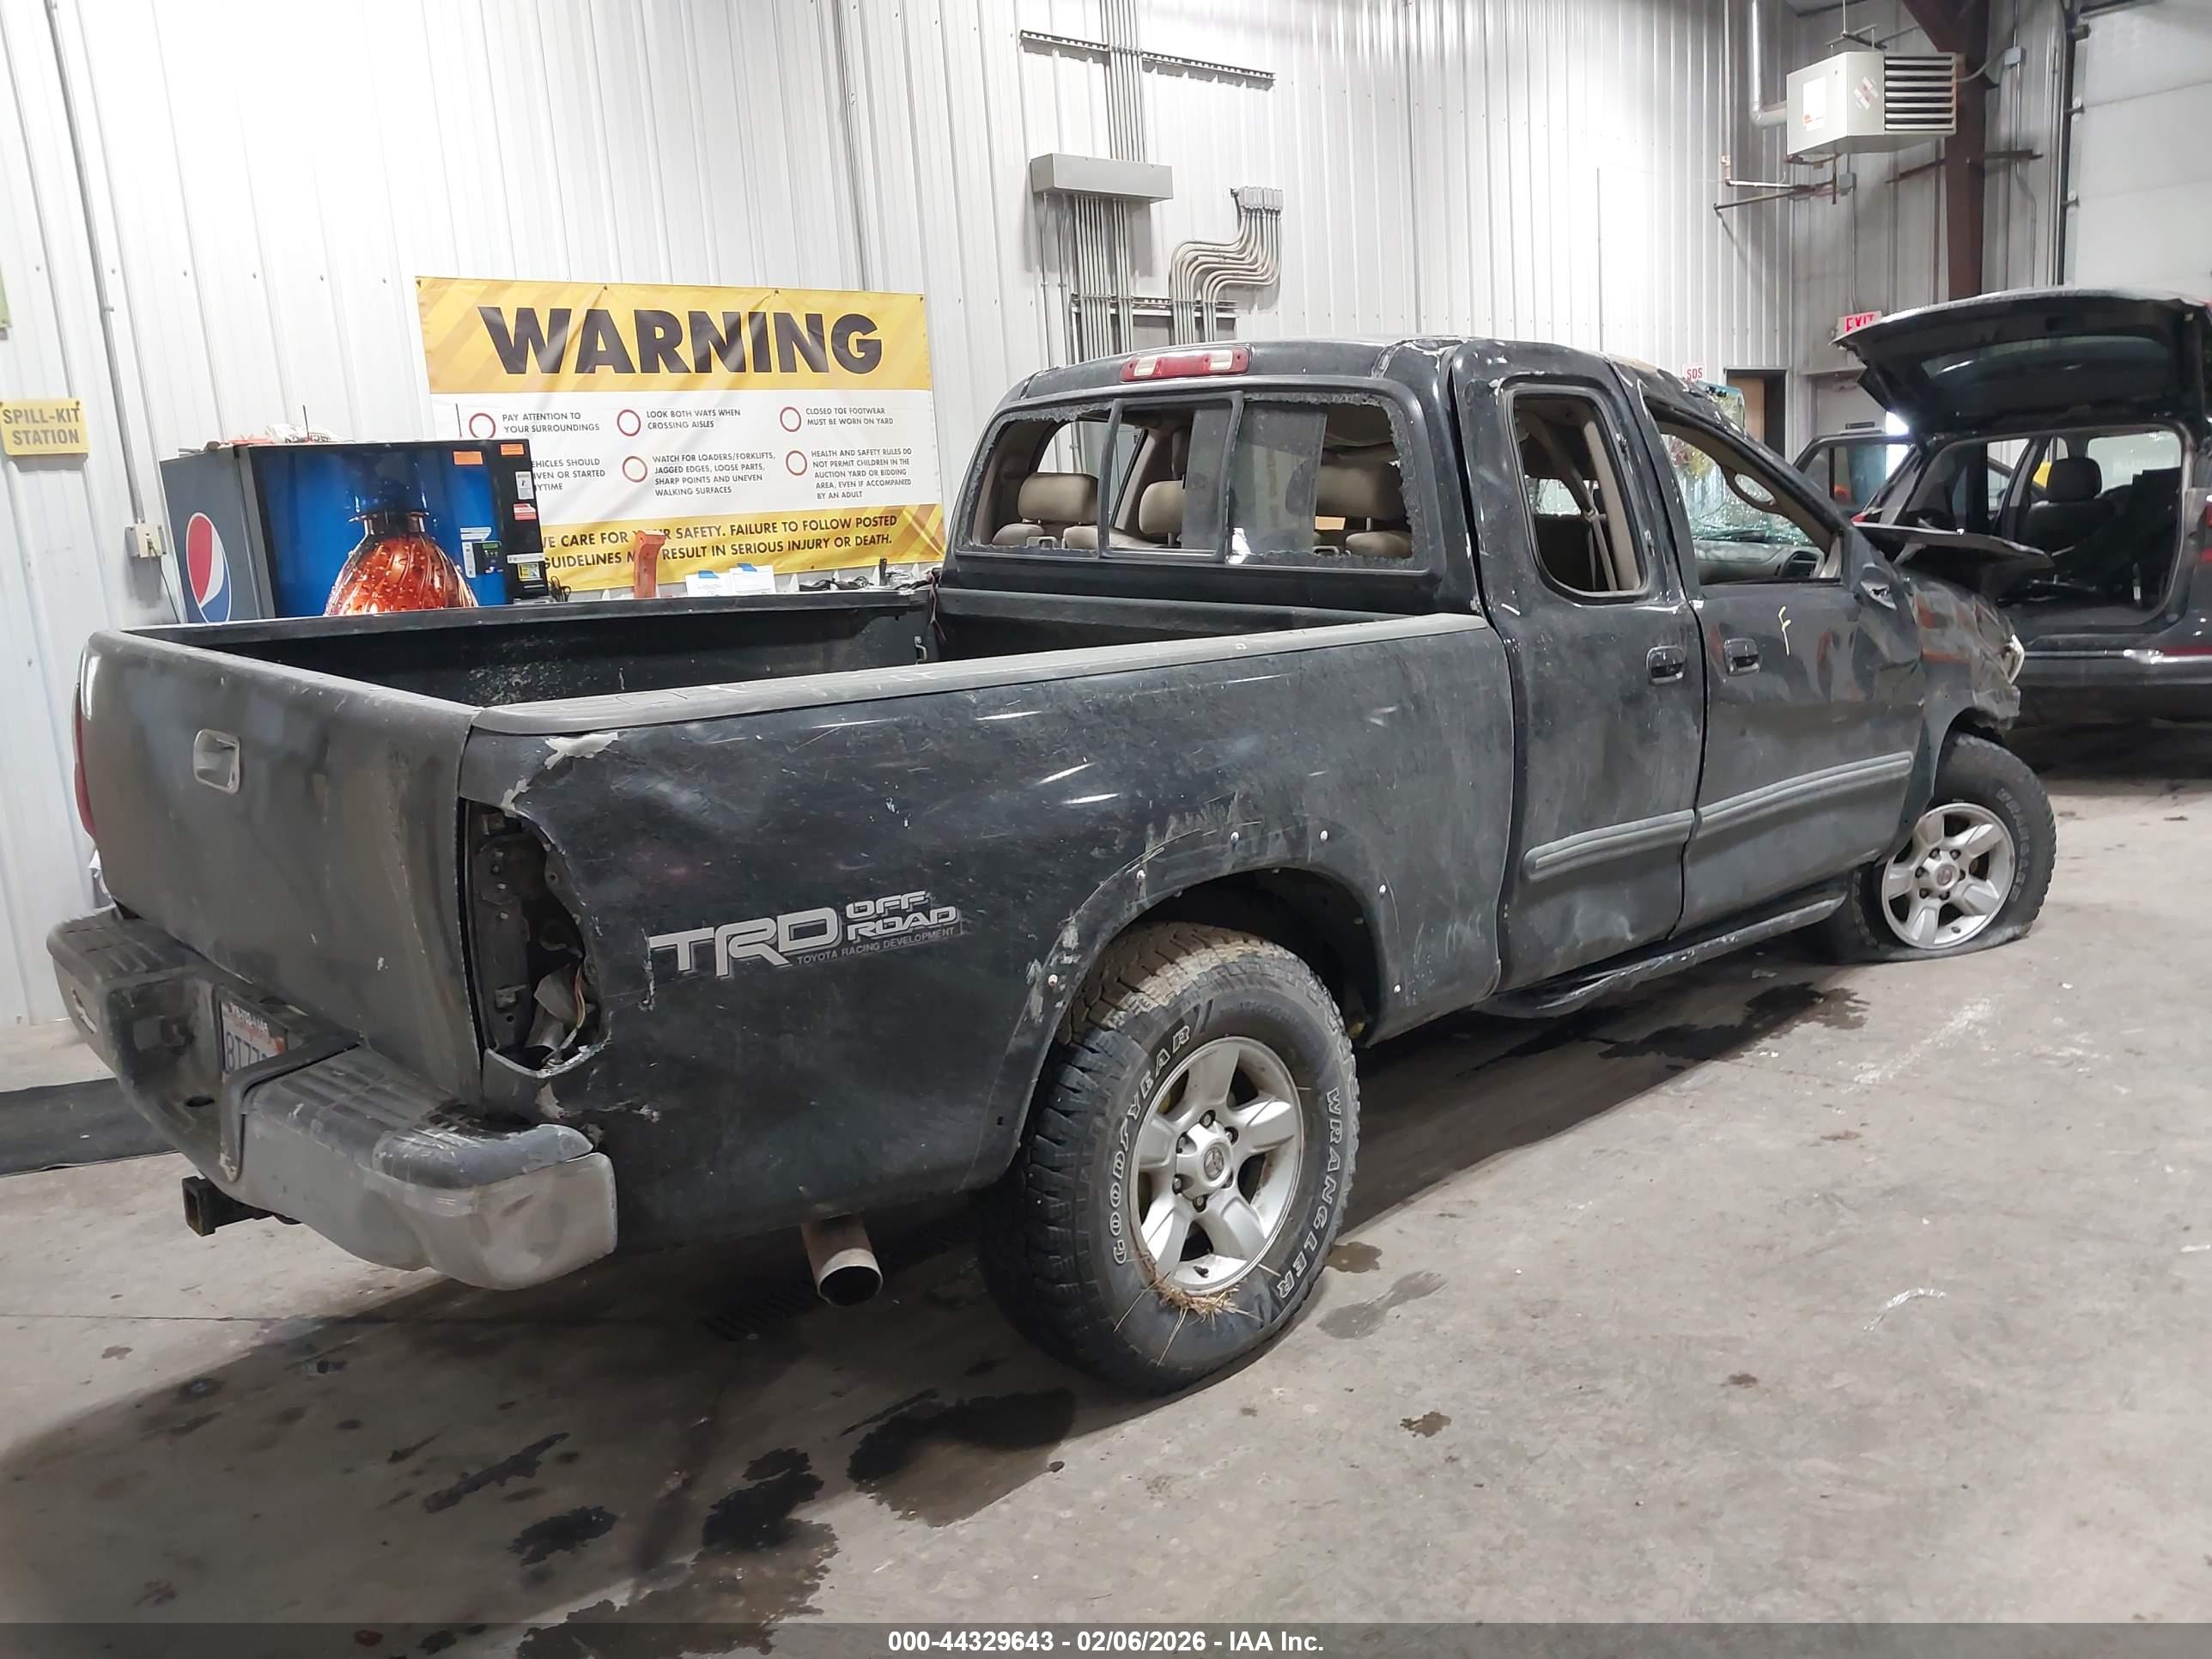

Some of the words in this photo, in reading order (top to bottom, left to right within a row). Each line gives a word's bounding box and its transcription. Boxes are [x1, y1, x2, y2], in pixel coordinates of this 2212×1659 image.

[477, 307, 882, 374] WARNING
[2, 408, 80, 424] SPILL-KIT
[671, 410, 692, 418] BOTH
[695, 409, 716, 417] WAYS
[504, 425, 529, 434] YOUR
[532, 423, 600, 433] SURROUNDINGS
[647, 421, 689, 430] CROSSING
[692, 420, 714, 428] AISLES
[12, 428, 80, 446] STATION
[532, 459, 564, 468] EHICLES
[567, 458, 600, 466] SHOULD
[653, 454, 680, 463] WATCH
[698, 452, 776, 462] LOADERS/FORKLIFTS,
[533, 471, 554, 480] IVEN
[557, 471, 570, 479] OR
[573, 469, 605, 477] STARTED
[654, 465, 684, 475] JAGGED
[686, 465, 712, 473] EDGES,
[714, 464, 738, 472] LOOSE
[741, 463, 765, 471] PARTS,
[537, 483, 563, 491] YTIME
[654, 477, 679, 485] SHARP
[683, 476, 711, 484] POINTS
[816, 481, 836, 489] AREA,
[866, 478, 912, 487] ACCOMPANIED
[655, 488, 693, 496] WALKING
[696, 486, 732, 495] SURFACES
[676, 525, 726, 539] SAFETY.
[730, 522, 778, 537] FAILURE
[782, 520, 799, 532] TO
[803, 518, 852, 532] FOLLOW
[855, 515, 897, 528] POSTED
[561, 532, 595, 547] CARE
[601, 531, 629, 544] FOR
[662, 545, 708, 561] RESULT
[712, 544, 726, 556] IN
[731, 540, 784, 555] SERIOUS
[788, 537, 830, 551] INJURY
[834, 536, 851, 548] OR
[855, 533, 892, 547] DEATH.
[845, 890, 928, 919] OFF
[847, 906, 957, 941] ROAD
[648, 907, 840, 978] TRD
[797, 950, 838, 965] TOYOTA
[841, 941, 880, 958] RACING
[883, 927, 955, 949] DEVELOPMENT
[1277, 1086, 1342, 1298] WRANGLER
